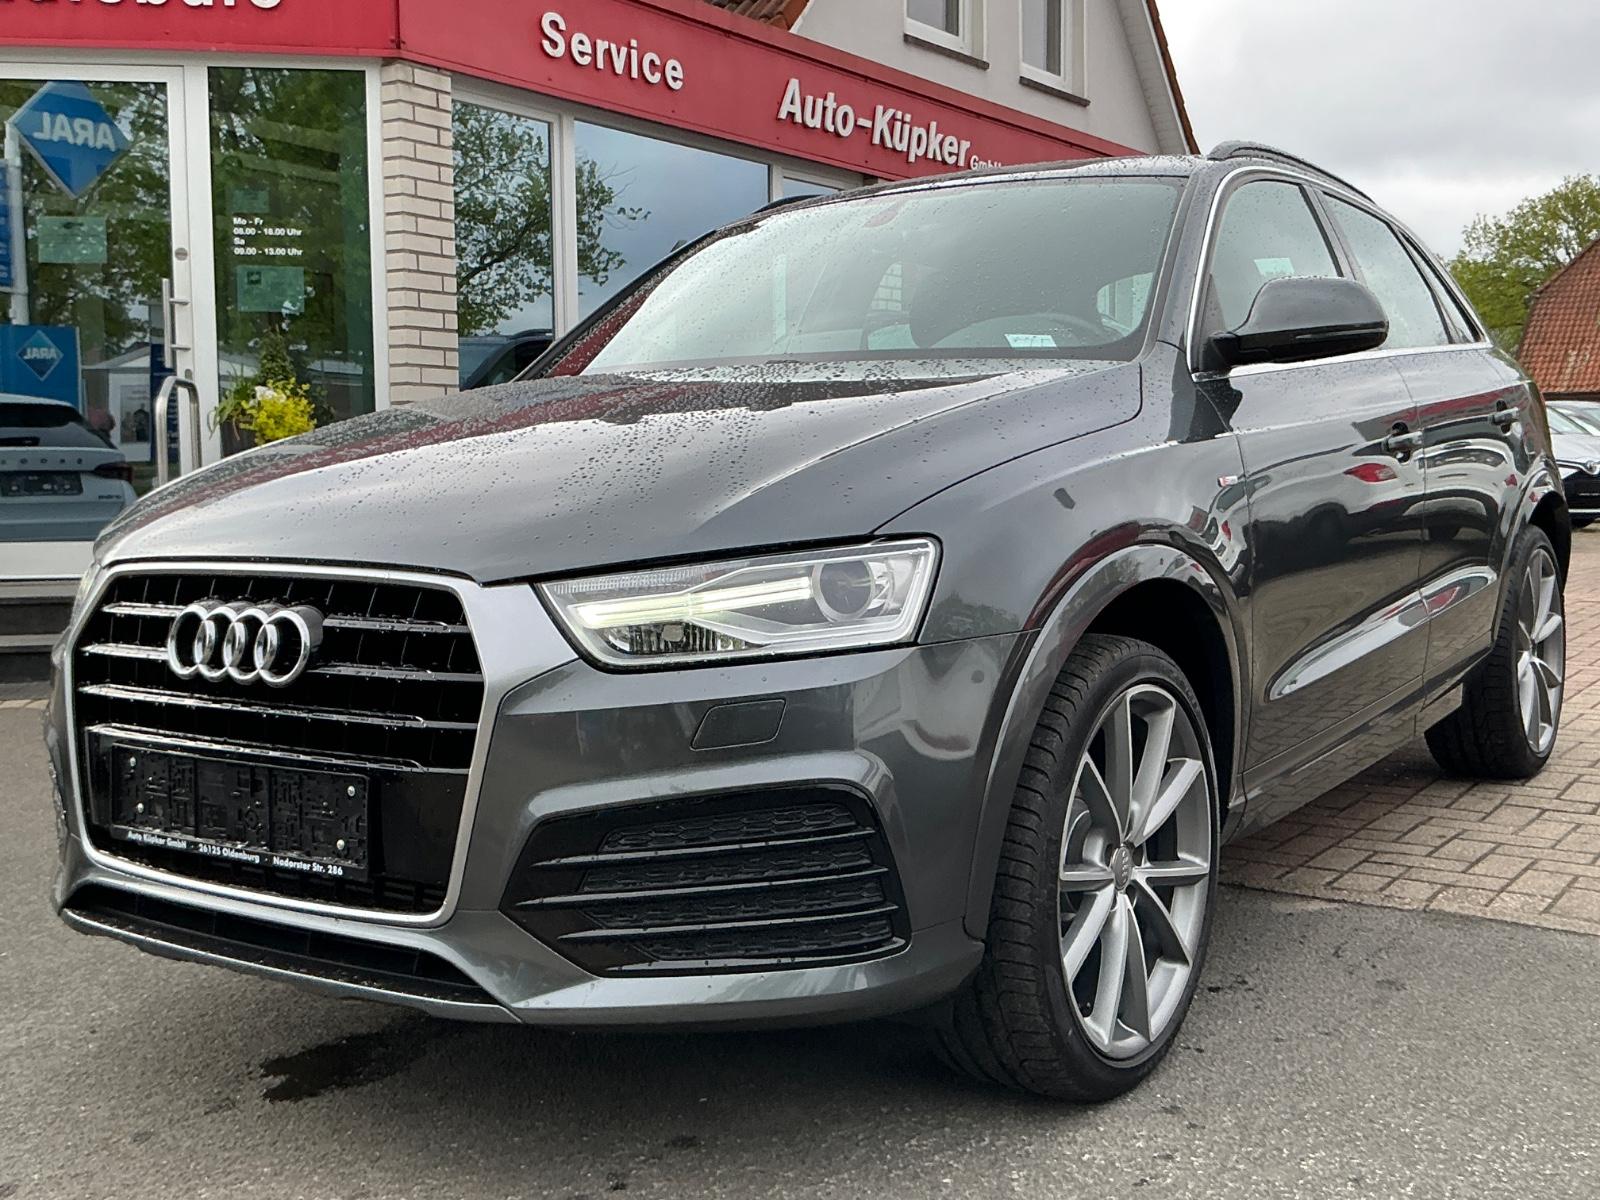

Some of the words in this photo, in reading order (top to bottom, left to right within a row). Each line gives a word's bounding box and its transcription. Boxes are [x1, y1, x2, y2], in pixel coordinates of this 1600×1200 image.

[540, 11, 684, 91] Service
[777, 77, 971, 167] Auto-Küpker
[233, 217, 247, 225] Mo
[255, 217, 264, 225] Fr
[287, 227, 302, 237] Uhr
[233, 238, 246, 246] Sa
[287, 248, 303, 257] Uhr
[166, 837, 187, 849] GmbH
[199, 843, 221, 856] 26125
[222, 847, 260, 864] Oldenburg
[312, 862, 326, 873] Str.
[327, 864, 343, 876] 286
